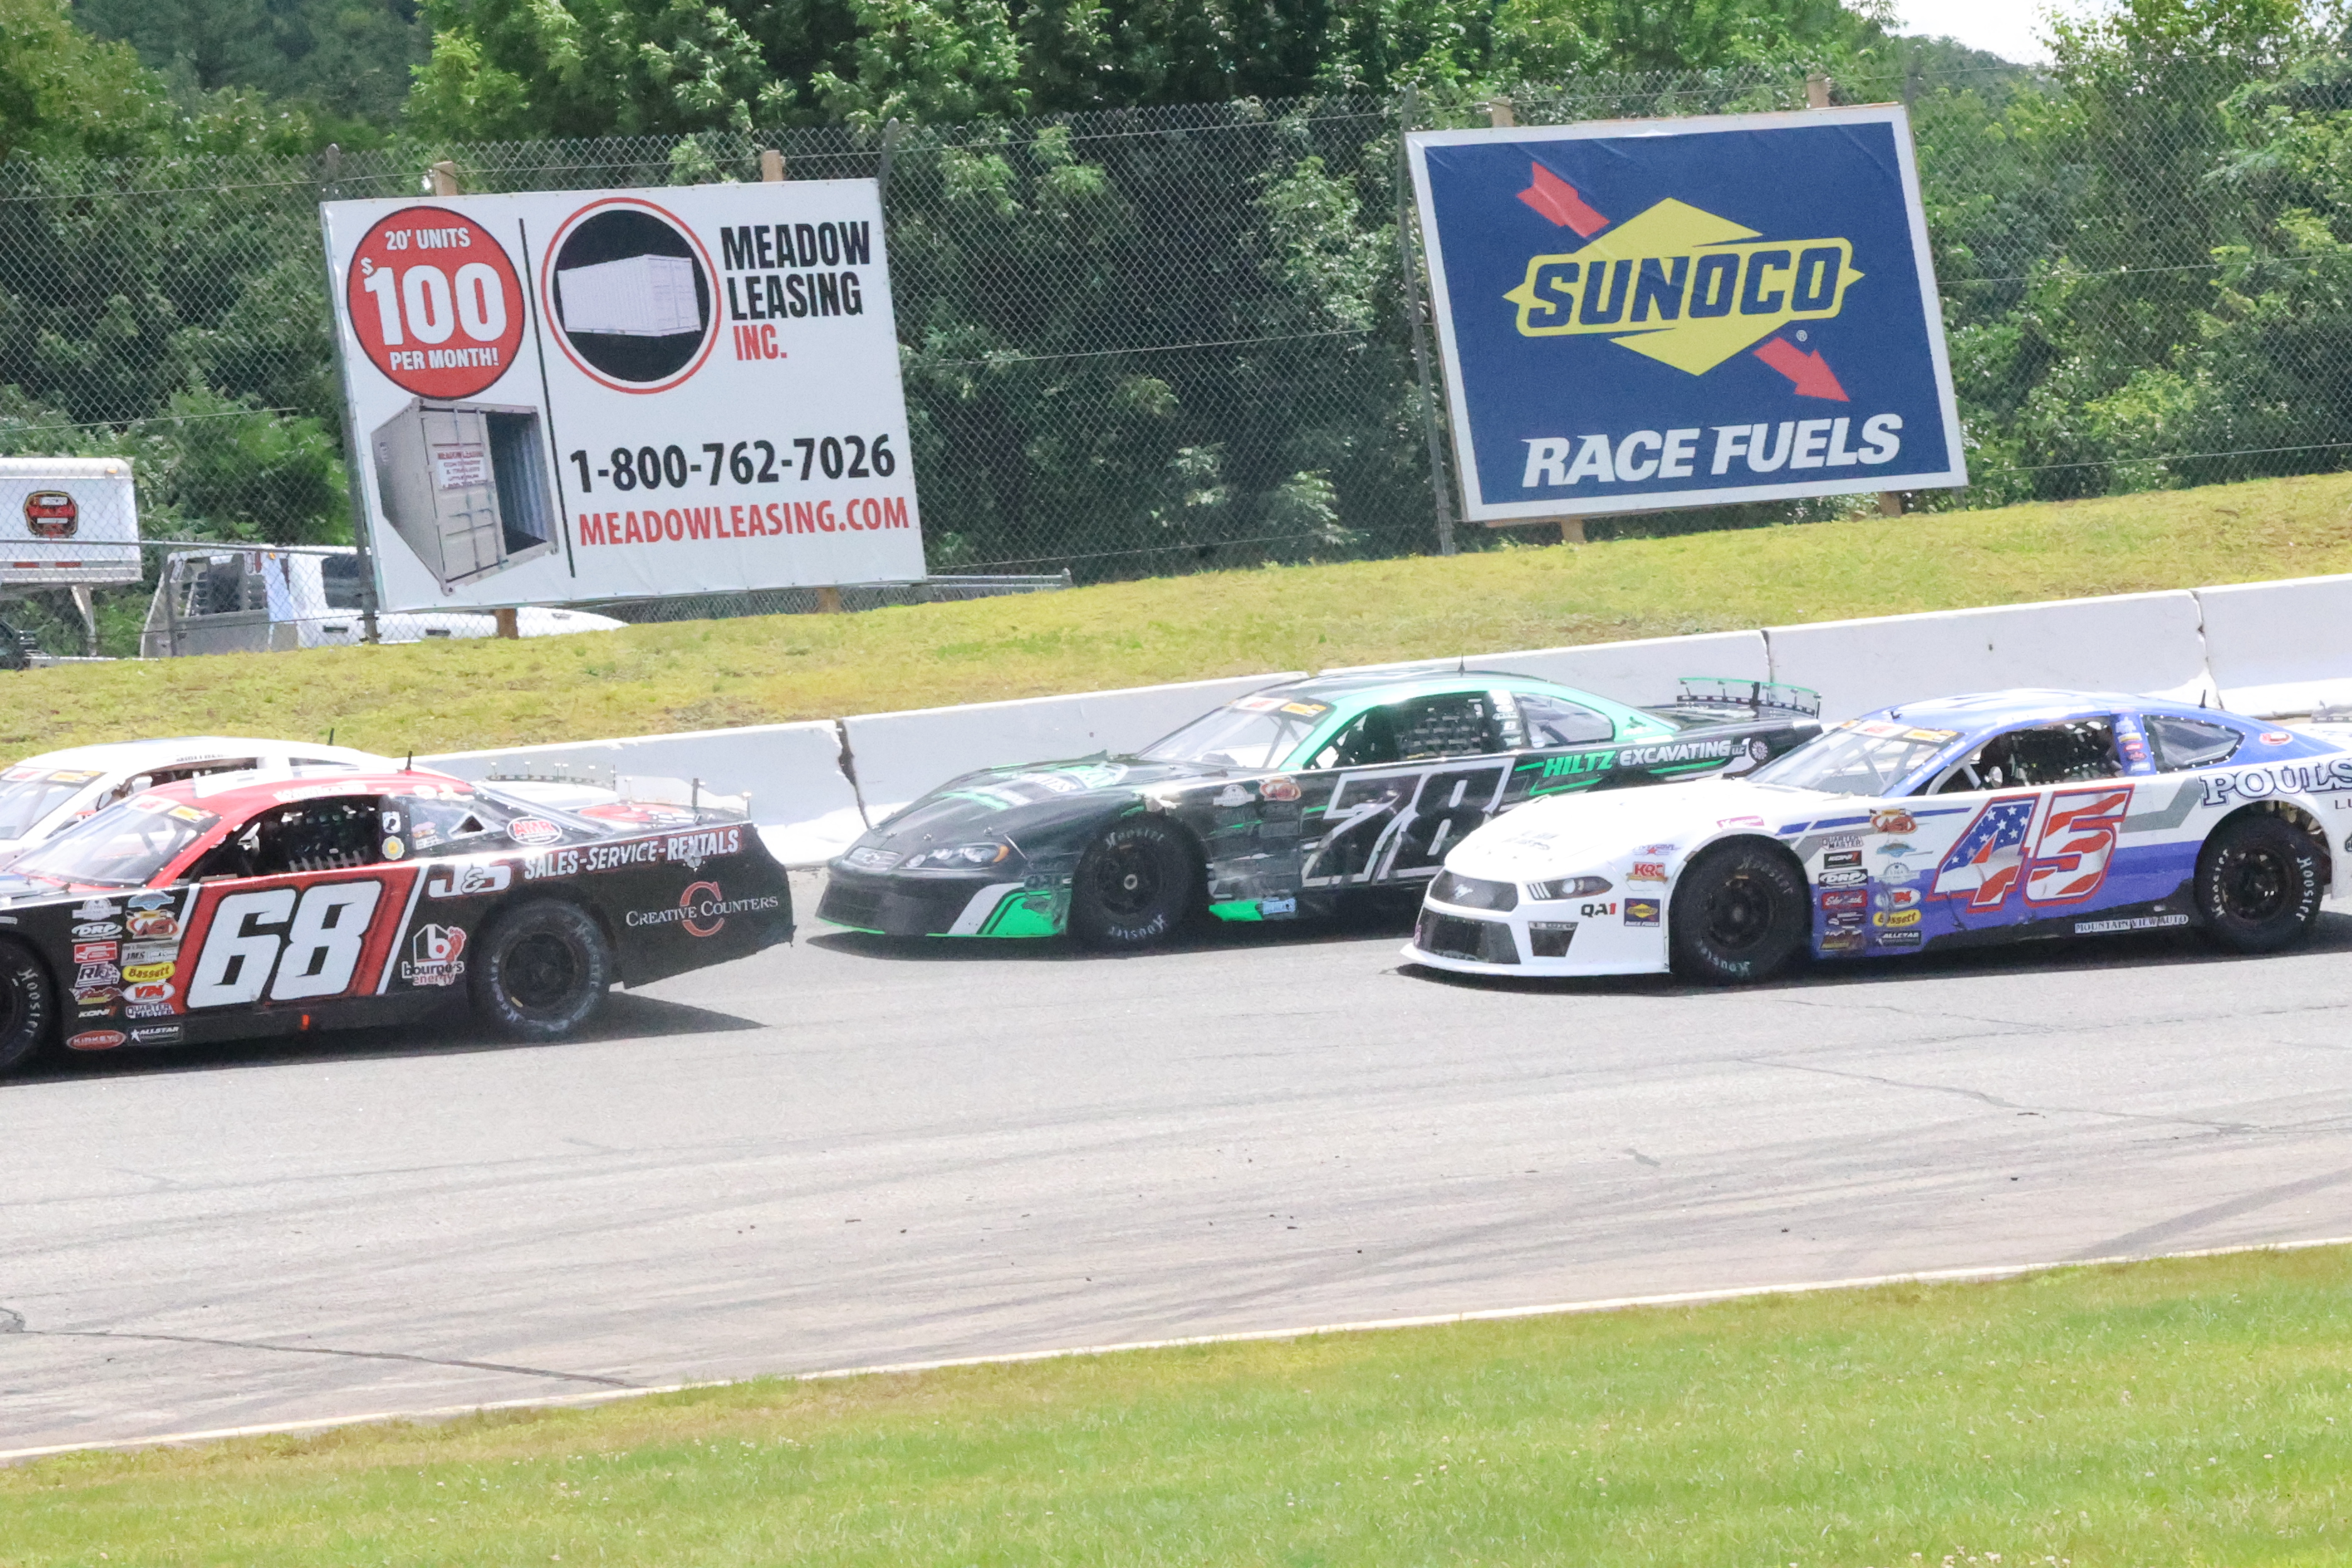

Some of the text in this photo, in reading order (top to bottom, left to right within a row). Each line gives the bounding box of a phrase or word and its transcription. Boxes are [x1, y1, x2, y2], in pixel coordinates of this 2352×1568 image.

[385, 227, 471, 251] 20' UNITS
[721, 220, 871, 271] MEADOW
[727, 271, 863, 320] LEASING
[1527, 246, 1843, 329] SUNOCO
[390, 347, 499, 371] PER MONTH!
[732, 324, 787, 361] INC.
[570, 434, 896, 493] 1-800-762-7026
[1522, 413, 1903, 487] RACE FUELS
[579, 497, 909, 546] MEADOWLEASING.COM
[1542, 751, 1617, 778] HILTZ
[1620, 740, 1731, 766] EXCAVATING
[513, 821, 556, 835] AMR
[1926, 784, 2135, 914] 45
[1635, 863, 1665, 877] KRC
[626, 896, 778, 927] CREATIVE COUNTERS
[1581, 903, 1617, 918] QA1
[2158, 914, 2187, 926] AUTO
[187, 881, 382, 1008] 68
[129, 965, 170, 979] Bassett
[79, 1009, 111, 1018] KONI
[139, 1026, 179, 1035] ALLSTAR
